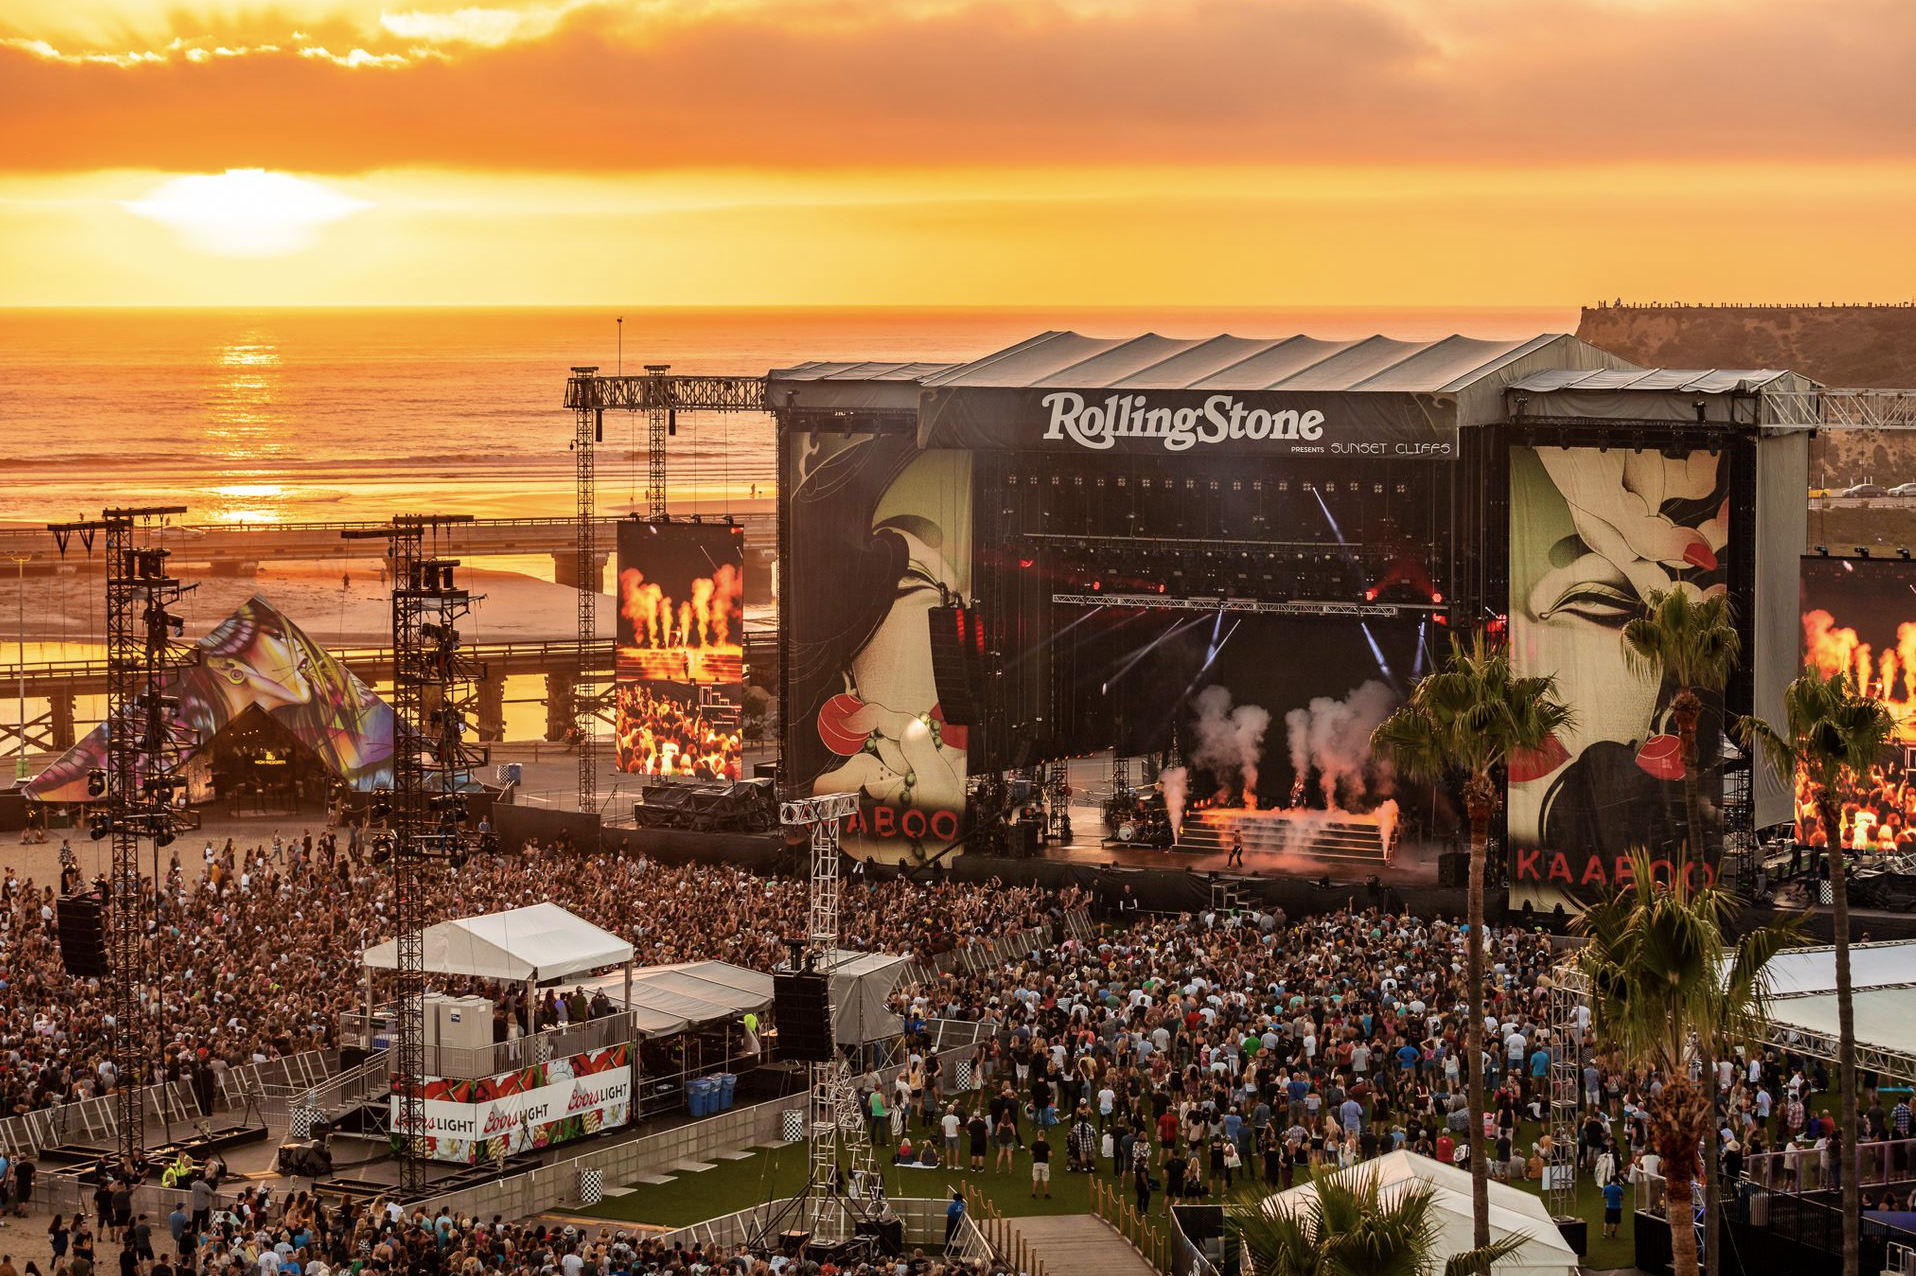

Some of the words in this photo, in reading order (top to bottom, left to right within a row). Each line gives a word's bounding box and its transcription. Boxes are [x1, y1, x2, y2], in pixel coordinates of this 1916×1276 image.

[1291, 446, 1325, 454] PRESENTS
[1330, 442, 1388, 454] SUNSET
[1395, 443, 1451, 455] CLIFFS
[792, 803, 958, 841] ABOO
[1516, 848, 1716, 890] KAABOO
[567, 1089, 600, 1110] Coors
[600, 1081, 627, 1102] LIGHT
[437, 1117, 474, 1133] LIGHT
[483, 1111, 518, 1133] Coors
